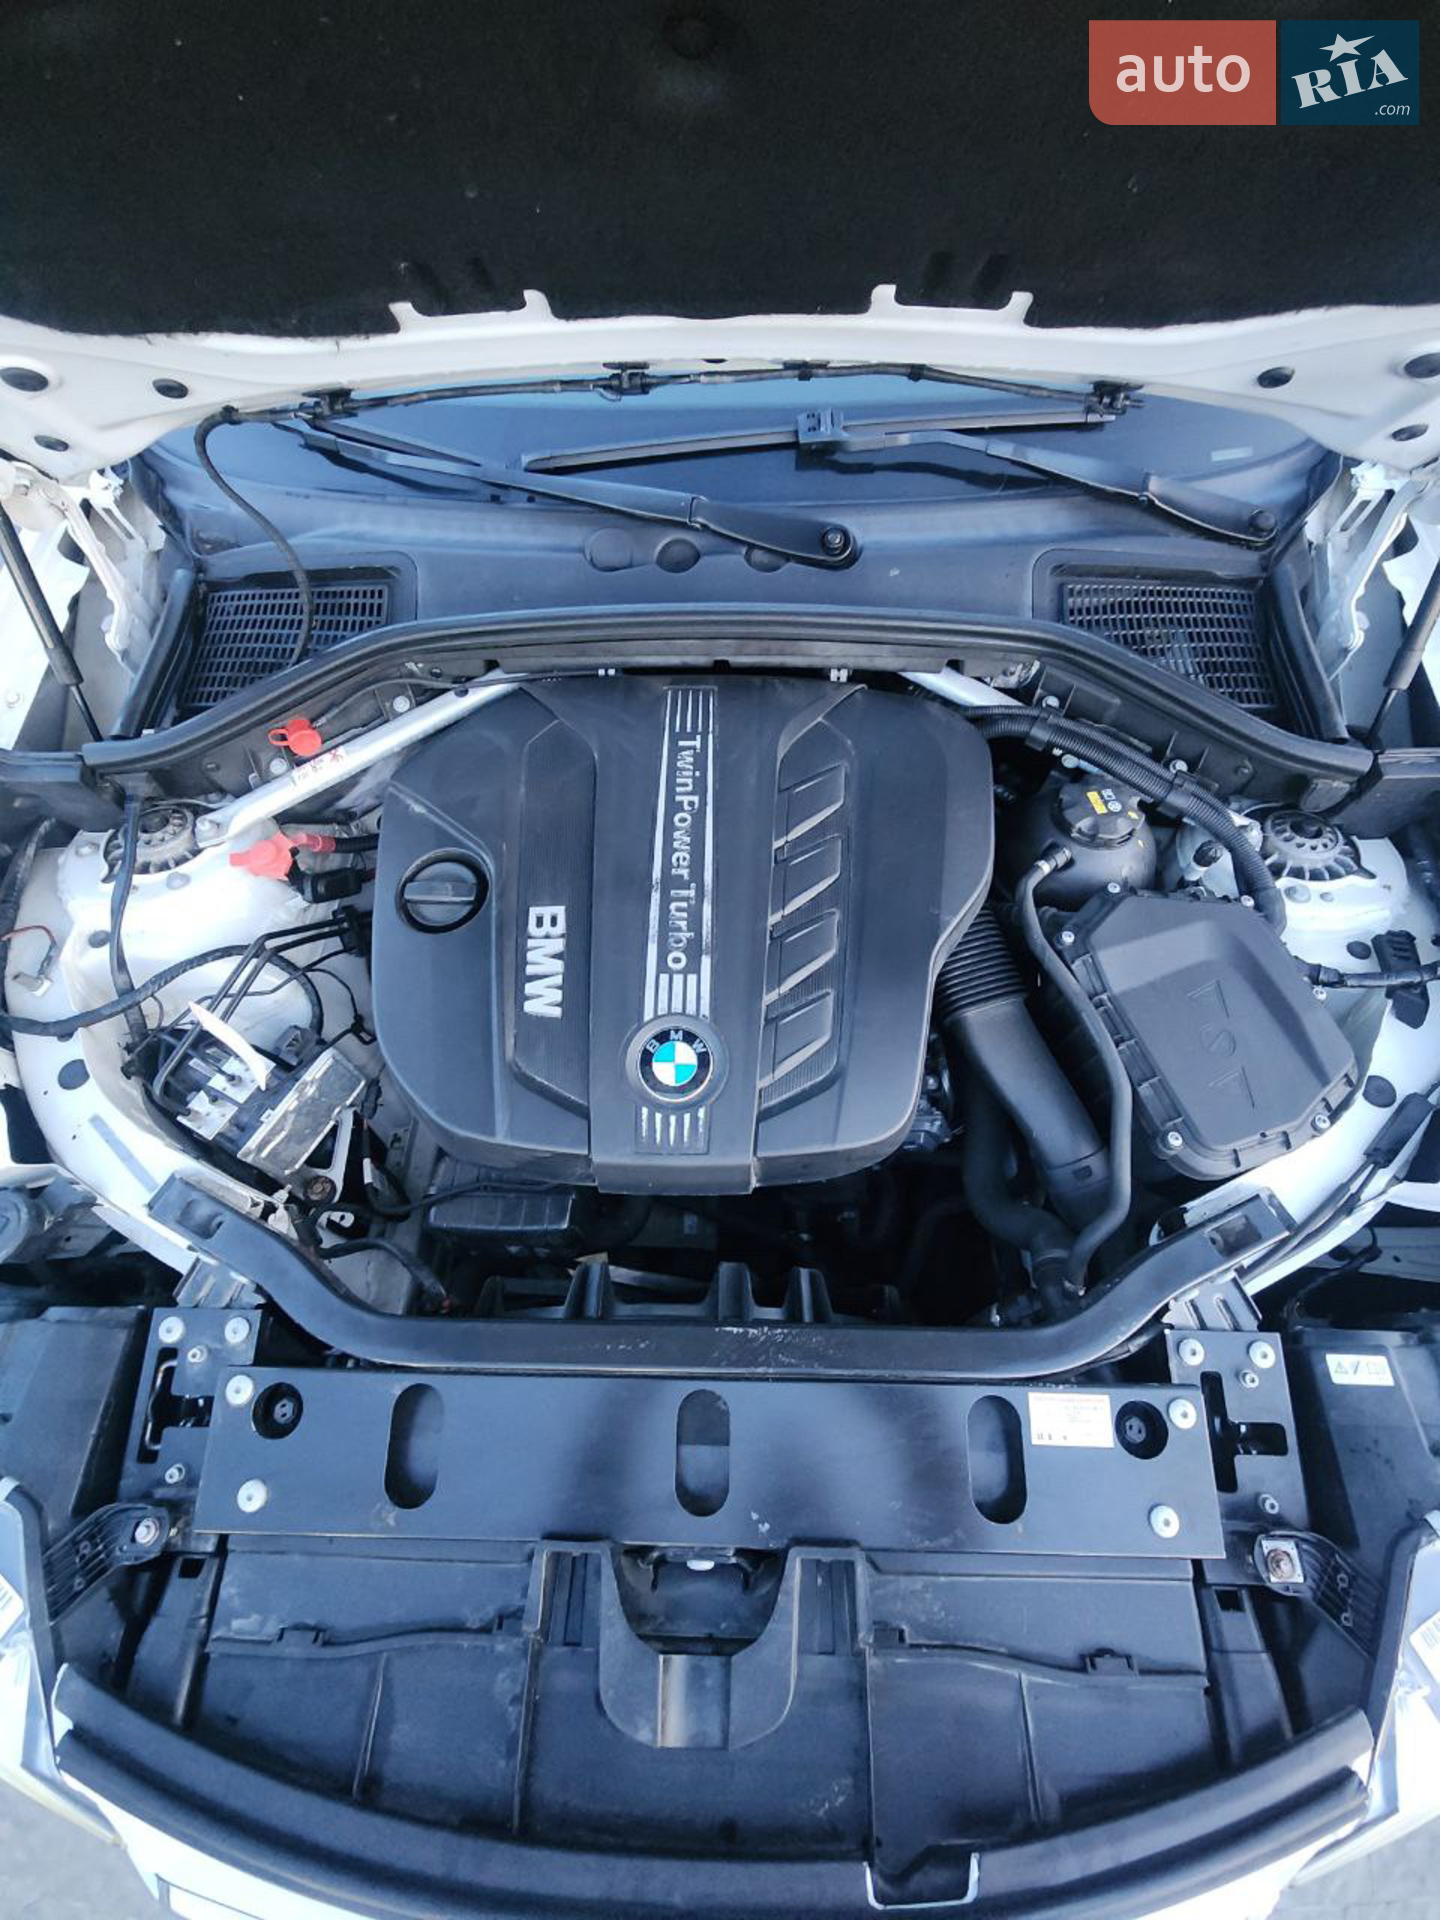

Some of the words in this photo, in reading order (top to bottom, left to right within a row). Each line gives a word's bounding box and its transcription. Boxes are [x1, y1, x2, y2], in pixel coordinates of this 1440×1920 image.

[671, 735, 701, 881] TwinPower
[523, 905, 566, 1019] BMW
[667, 883, 697, 971] Turbo
[646, 1029, 707, 1054] BMW
